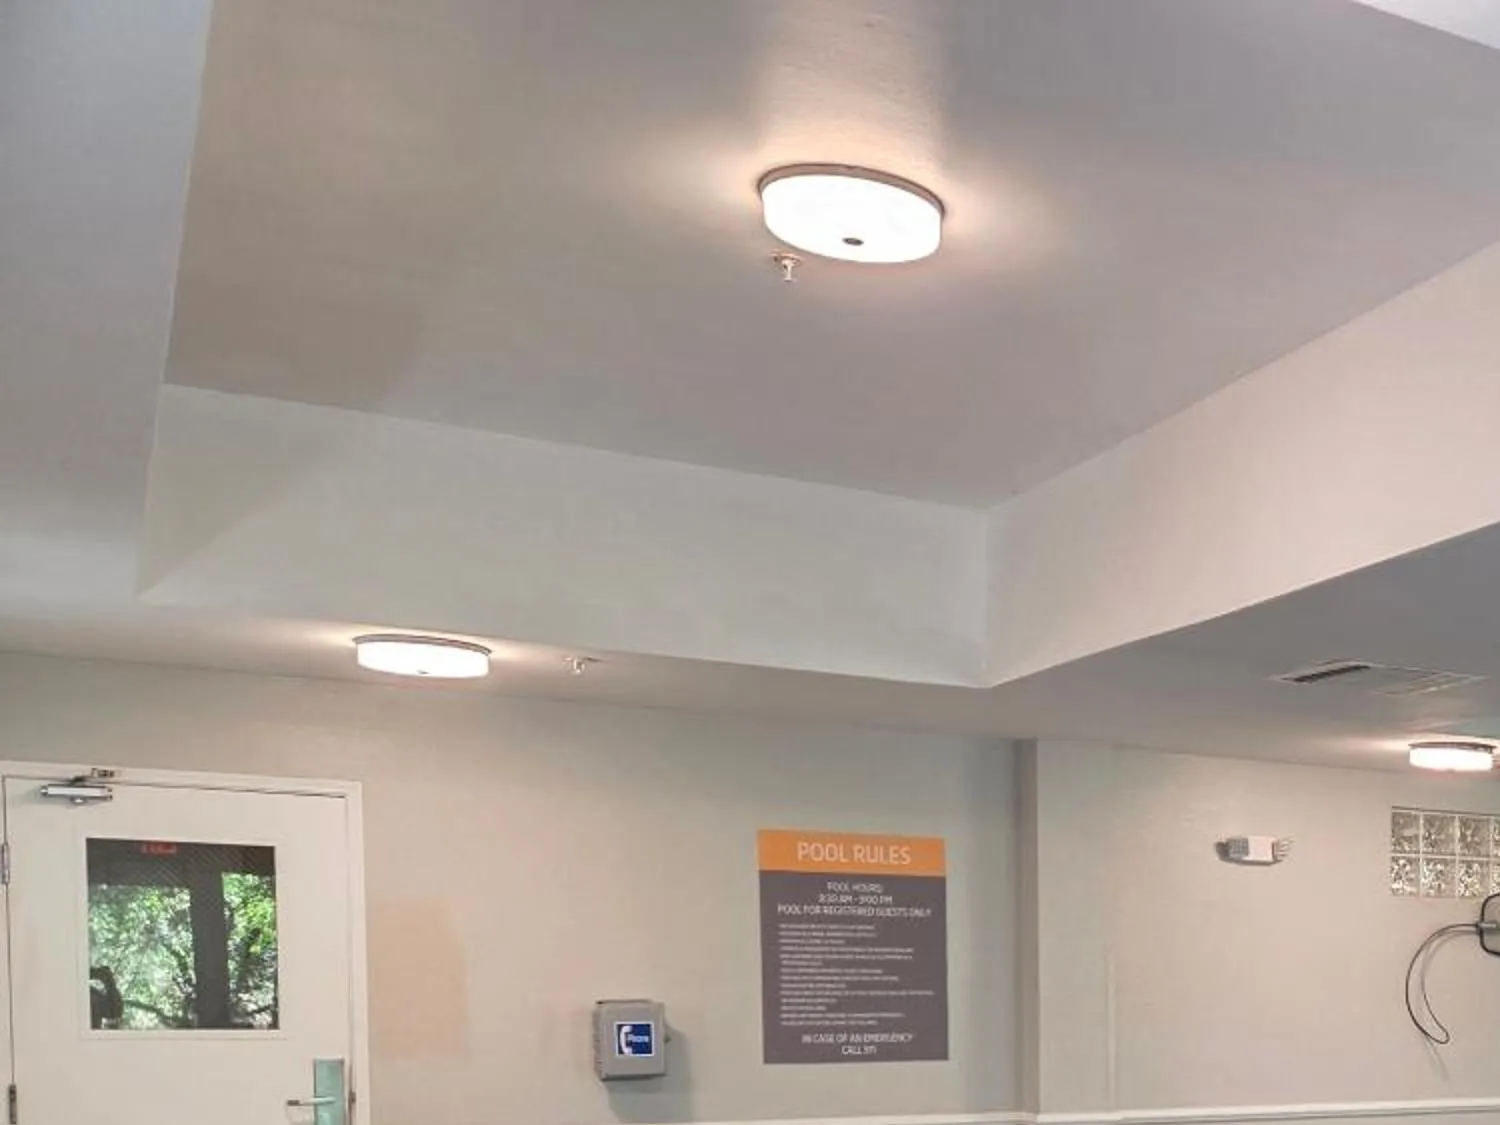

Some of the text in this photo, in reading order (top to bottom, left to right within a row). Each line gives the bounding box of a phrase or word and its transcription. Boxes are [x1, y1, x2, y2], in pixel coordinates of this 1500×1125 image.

[797, 842, 911, 865] POOL RULES
[827, 881, 850, 892] POOL
[777, 903, 801, 916] POOL
